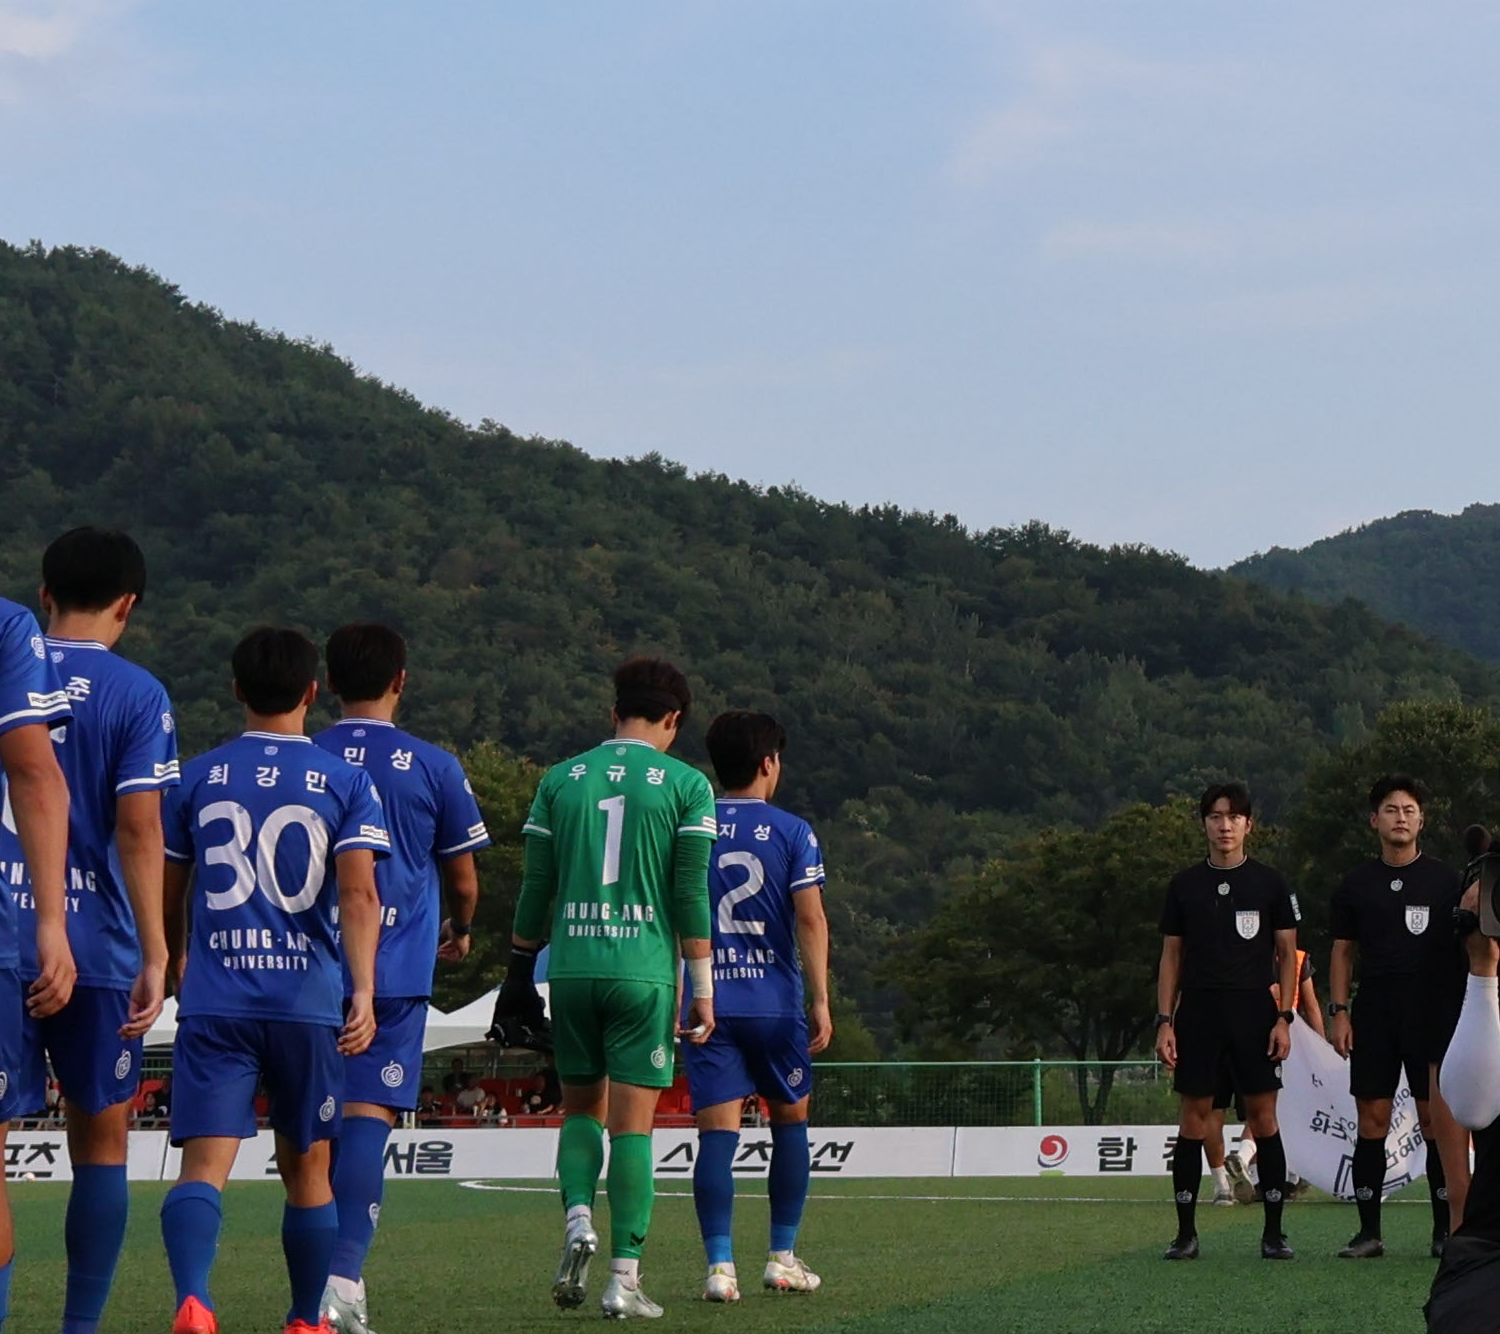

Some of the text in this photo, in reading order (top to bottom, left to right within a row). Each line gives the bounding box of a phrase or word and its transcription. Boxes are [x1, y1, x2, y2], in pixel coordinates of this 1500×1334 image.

[344, 746, 413, 771] 민성
[598, 795, 625, 886] 1
[718, 823, 772, 841] 지성
[198, 800, 329, 914] 30
[718, 851, 765, 936] 2
[568, 925, 640, 938] UNIVERSITY
[711, 947, 776, 965] NG-ANG
[714, 968, 765, 981] IVERSITY
